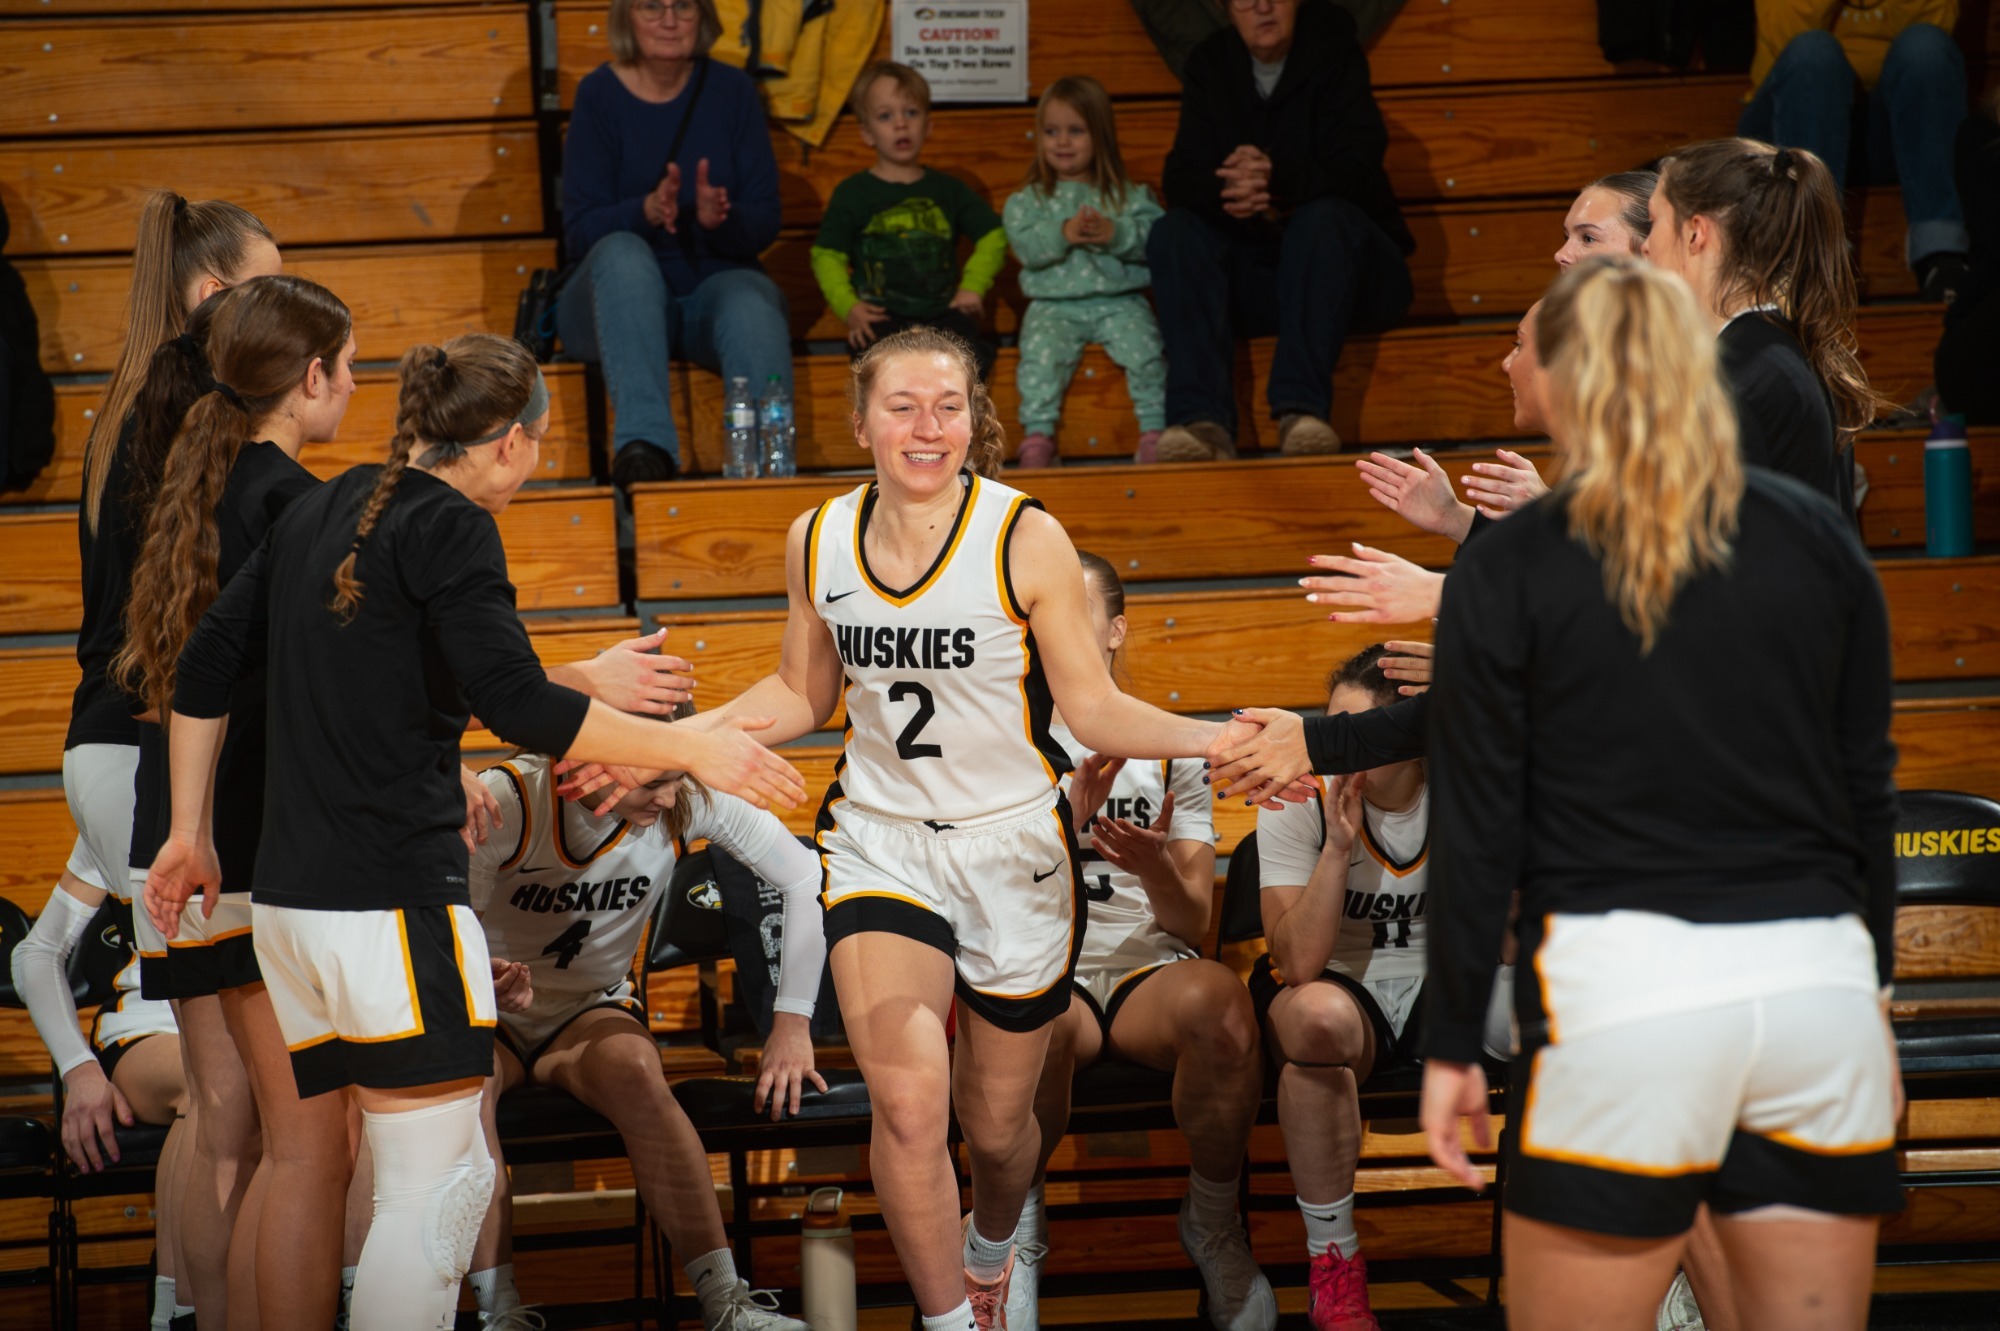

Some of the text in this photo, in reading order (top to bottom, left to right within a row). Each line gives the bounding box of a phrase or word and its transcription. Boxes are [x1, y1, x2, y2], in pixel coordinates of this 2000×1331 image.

[984, 10, 1005, 18] TECH
[919, 28, 1000, 41] CAUTION!
[905, 46, 1015, 55] Do Not Sit Or Stand
[909, 59, 1011, 71] On Top Two Rows
[837, 624, 975, 669] HUSKIES
[888, 681, 942, 760] 2
[510, 876, 650, 913] HUSKIES
[542, 920, 592, 969] 4
[1372, 920, 1411, 948] 11
